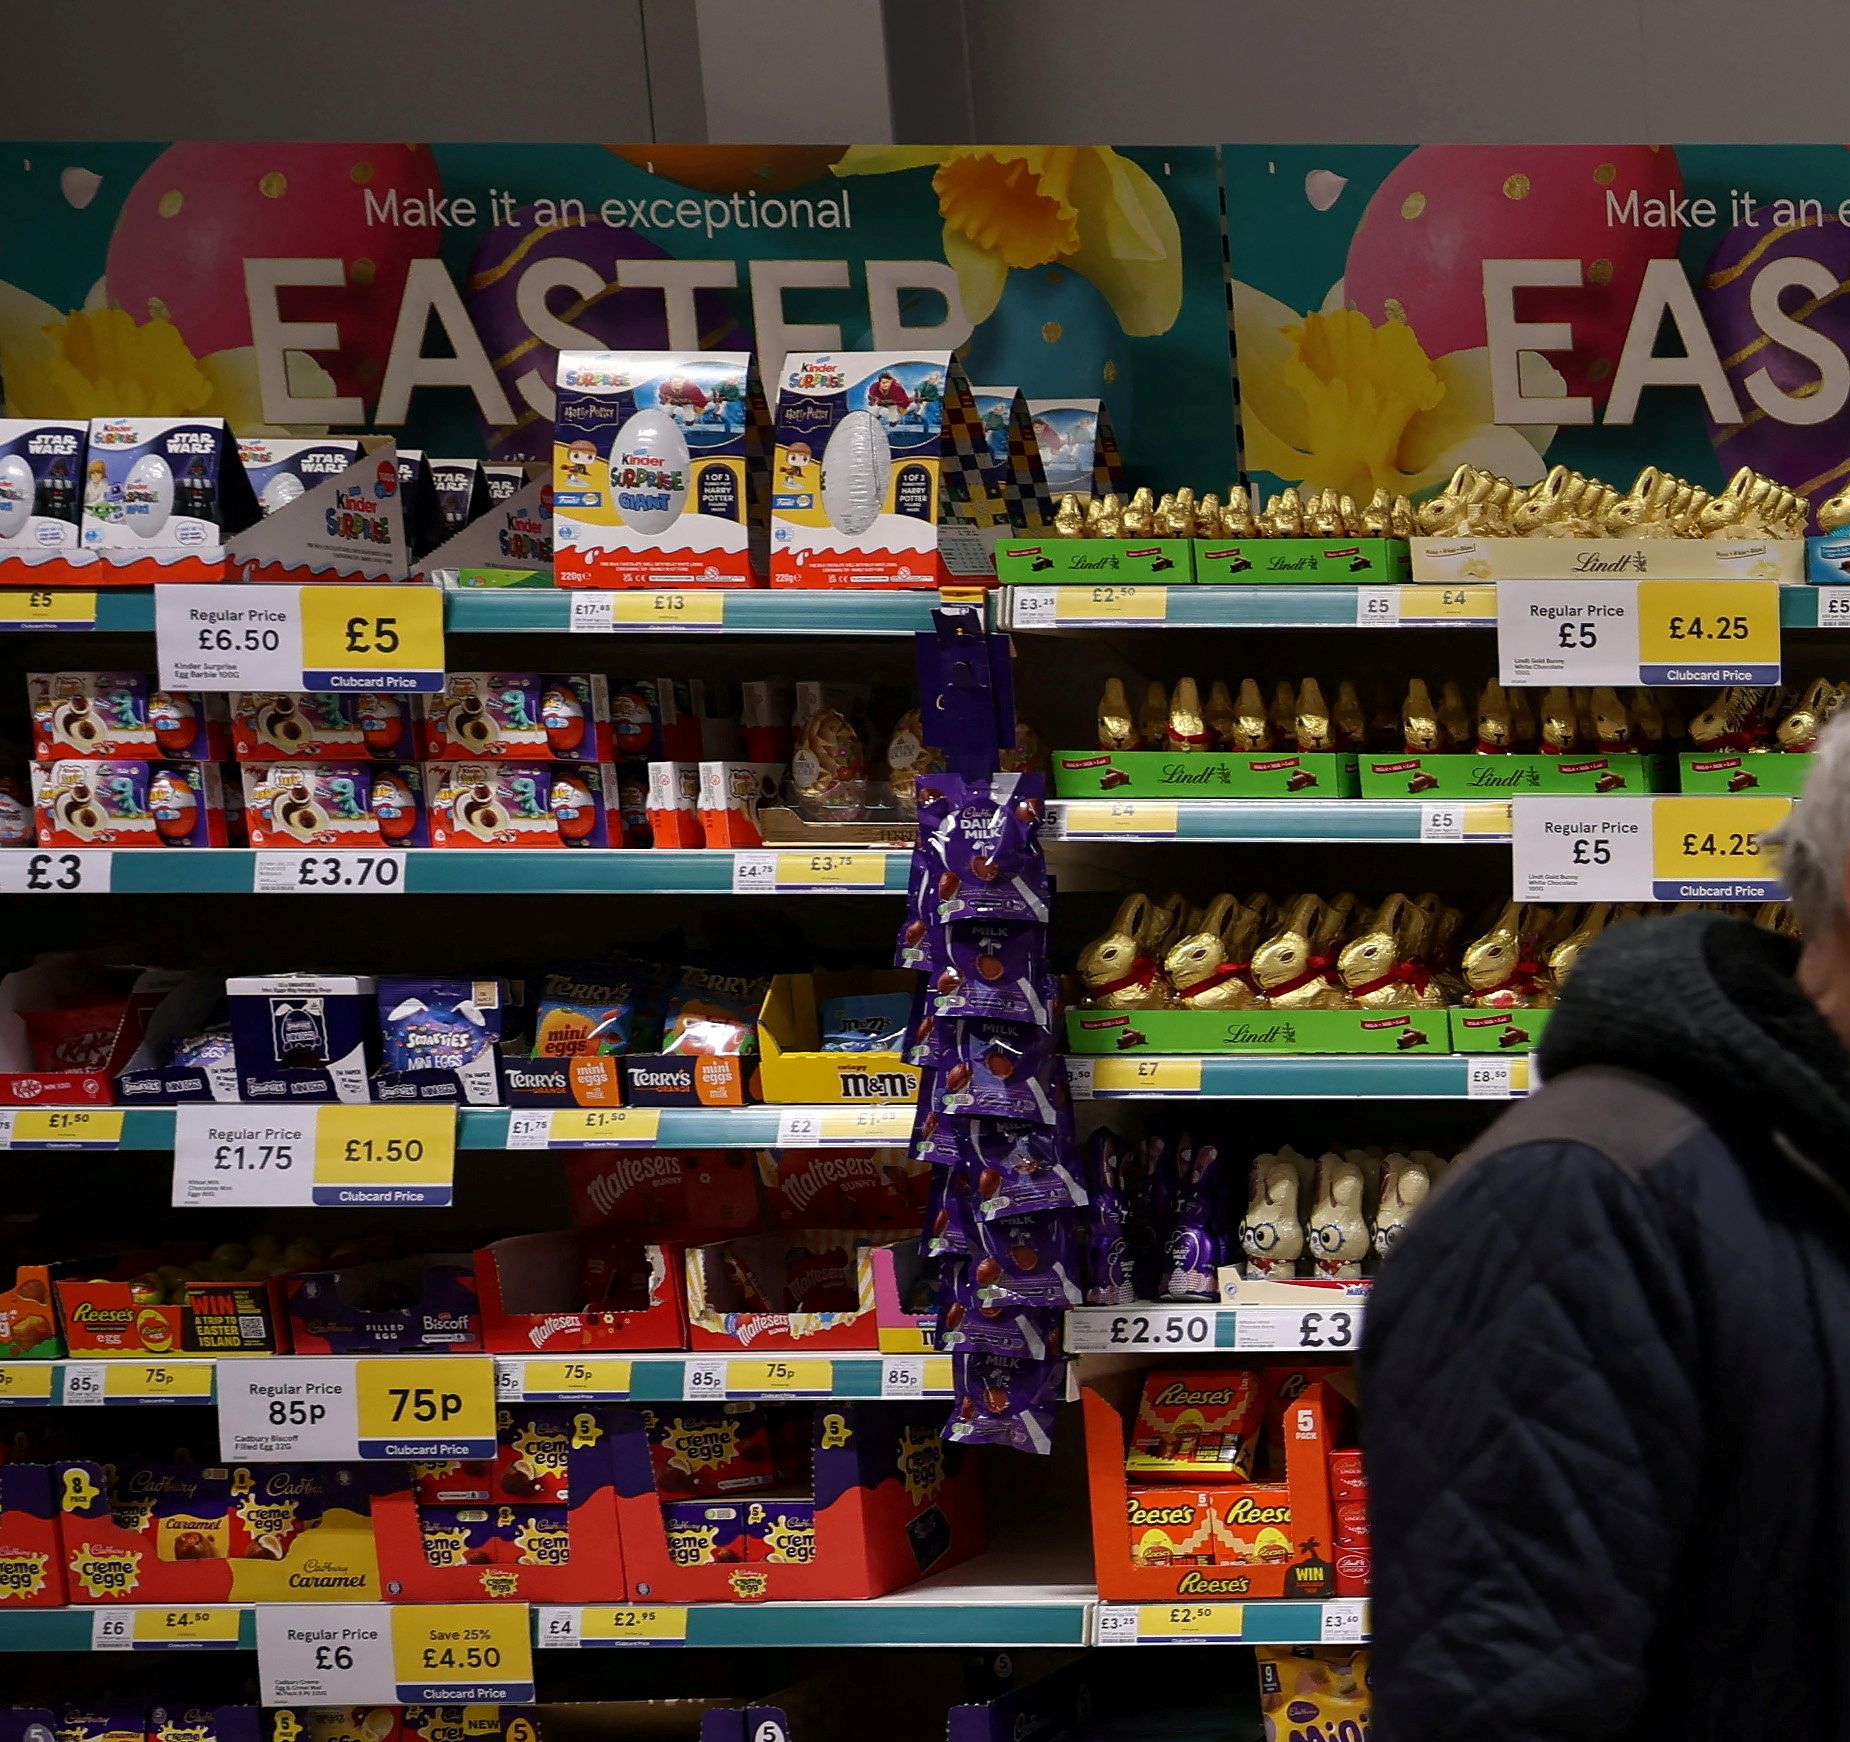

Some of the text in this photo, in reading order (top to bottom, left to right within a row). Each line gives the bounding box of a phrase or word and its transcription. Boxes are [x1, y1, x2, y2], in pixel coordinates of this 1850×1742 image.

[363, 188, 853, 235] Make it an exceptional
[1604, 188, 1718, 227] Make
[1729, 188, 1757, 227] it
[1772, 196, 1825, 227] an
[189, 607, 286, 625] Regular Price
[1529, 604, 1624, 619] Regular Price
[198, 628, 280, 652] £6.50
[345, 618, 399, 653] £5
[1558, 622, 1598, 649] £5
[1668, 616, 1749, 640] £4.25
[330, 675, 417, 688] Clubcard Price
[1667, 670, 1752, 682] Clubcard Price
[27, 855, 81, 889] £3
[298, 856, 398, 887] £3.70
[209, 1127, 301, 1142] Regular Price
[214, 1145, 292, 1172] £1.75
[345, 1138, 423, 1163] £1.50
[339, 1190, 425, 1202] Clubcard Price
[1110, 1315, 1208, 1344] £2.50
[1300, 1313, 1352, 1346] £3
[268, 1400, 327, 1427] 85p
[389, 1387, 462, 1423] 75p
[286, 1627, 379, 1642] Regular Price
[315, 1644, 353, 1671] £6
[421, 1645, 501, 1670] £4.50
